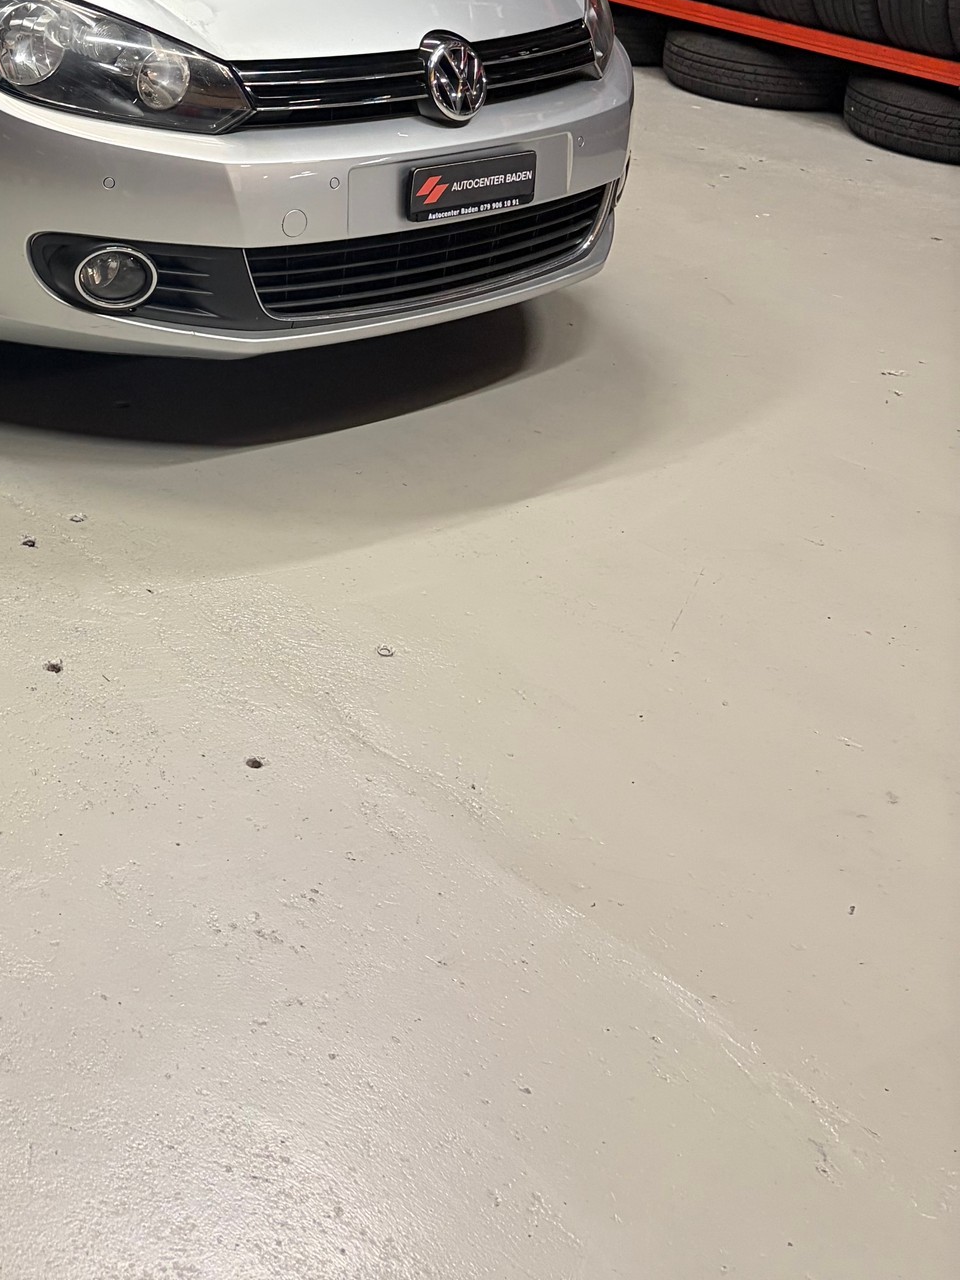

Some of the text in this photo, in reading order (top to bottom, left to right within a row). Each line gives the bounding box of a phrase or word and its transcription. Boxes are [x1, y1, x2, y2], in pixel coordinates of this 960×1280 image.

[451, 170, 533, 192] AUTOCENTER BADEN
[428, 208, 460, 220] Autocenter
[460, 205, 479, 215] Baden
[479, 203, 491, 212] 079
[492, 201, 503, 210] 906
[512, 198, 520, 206] 91
